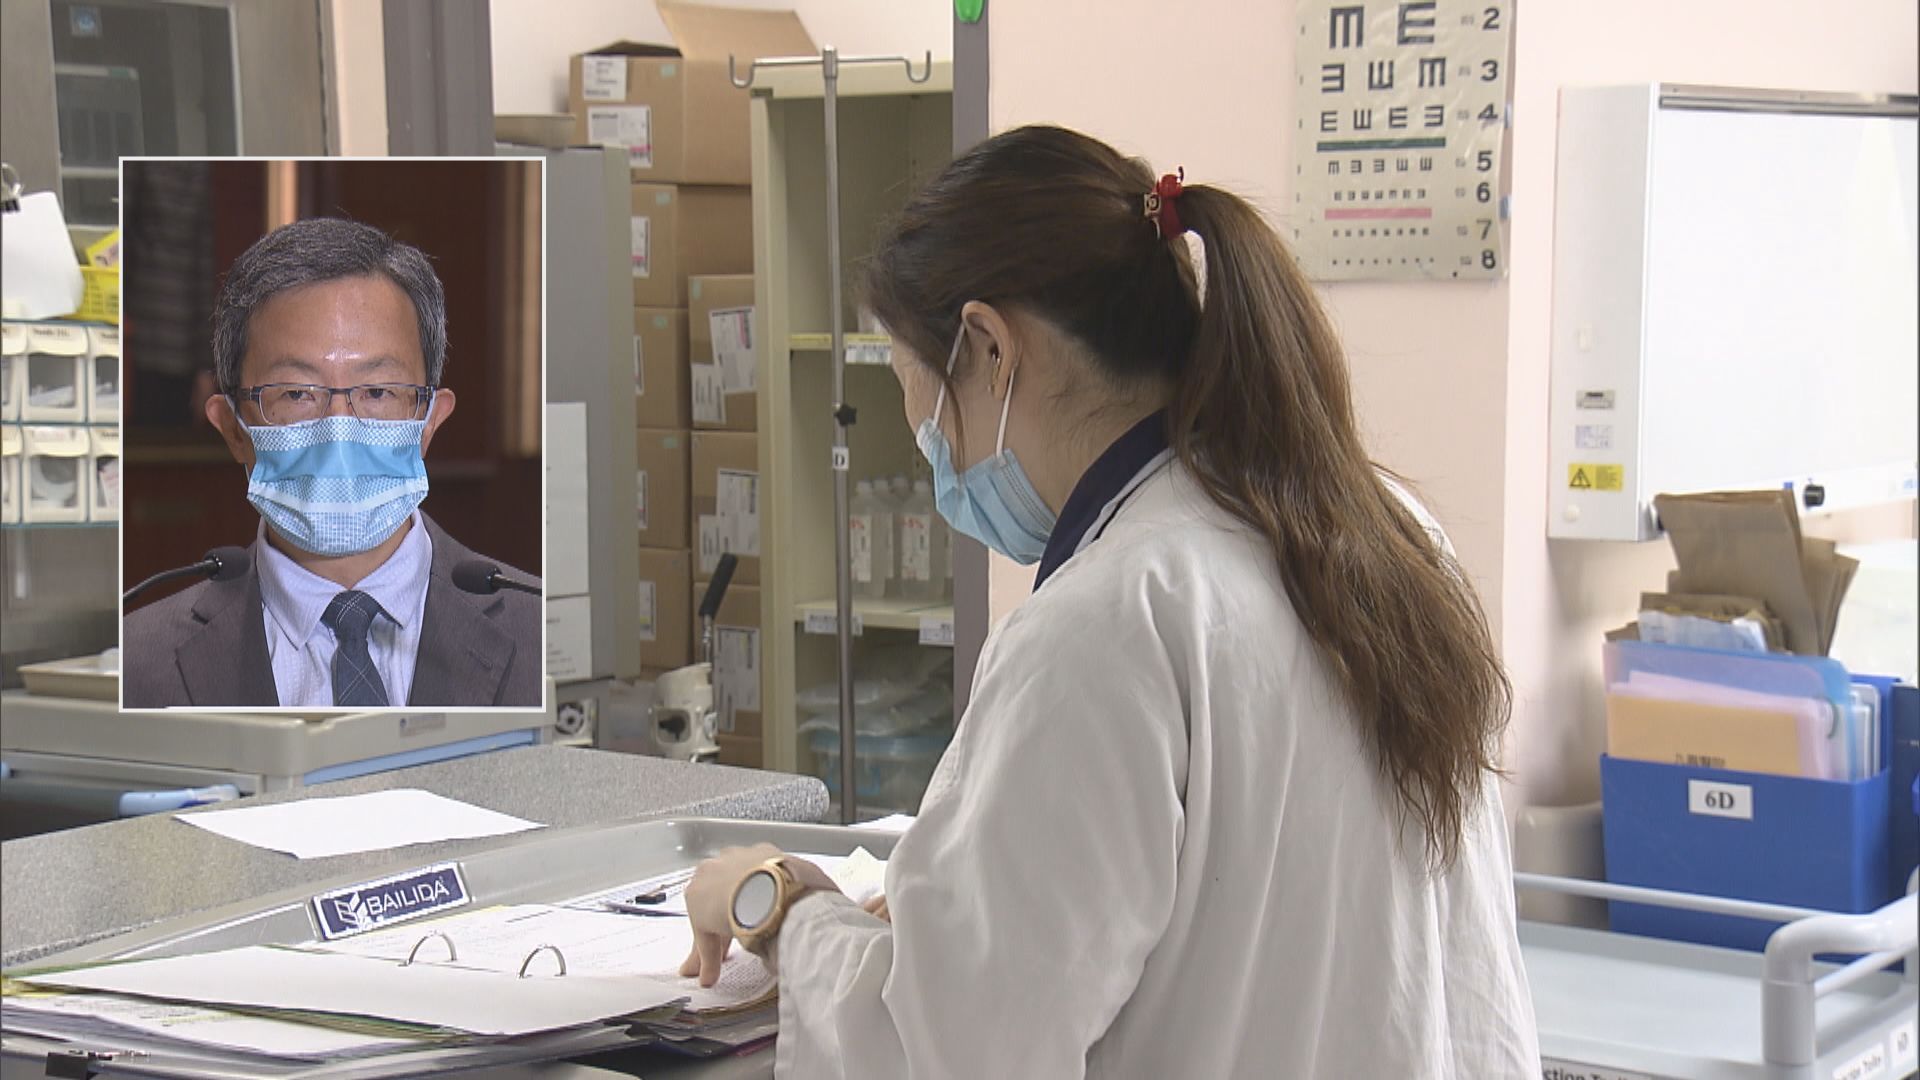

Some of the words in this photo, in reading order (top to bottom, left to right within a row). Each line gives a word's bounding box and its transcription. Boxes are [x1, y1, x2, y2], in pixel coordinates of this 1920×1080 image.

[1482, 7, 1501, 31] 2
[1480, 59, 1499, 82] 3
[1477, 103, 1499, 122] 4
[1476, 150, 1493, 172] 5
[1476, 181, 1491, 204] 6
[1476, 218, 1493, 241] 7
[1480, 249, 1497, 270] 8
[1705, 790, 1735, 810] 6D
[366, 879, 450, 916] BAILIDA
